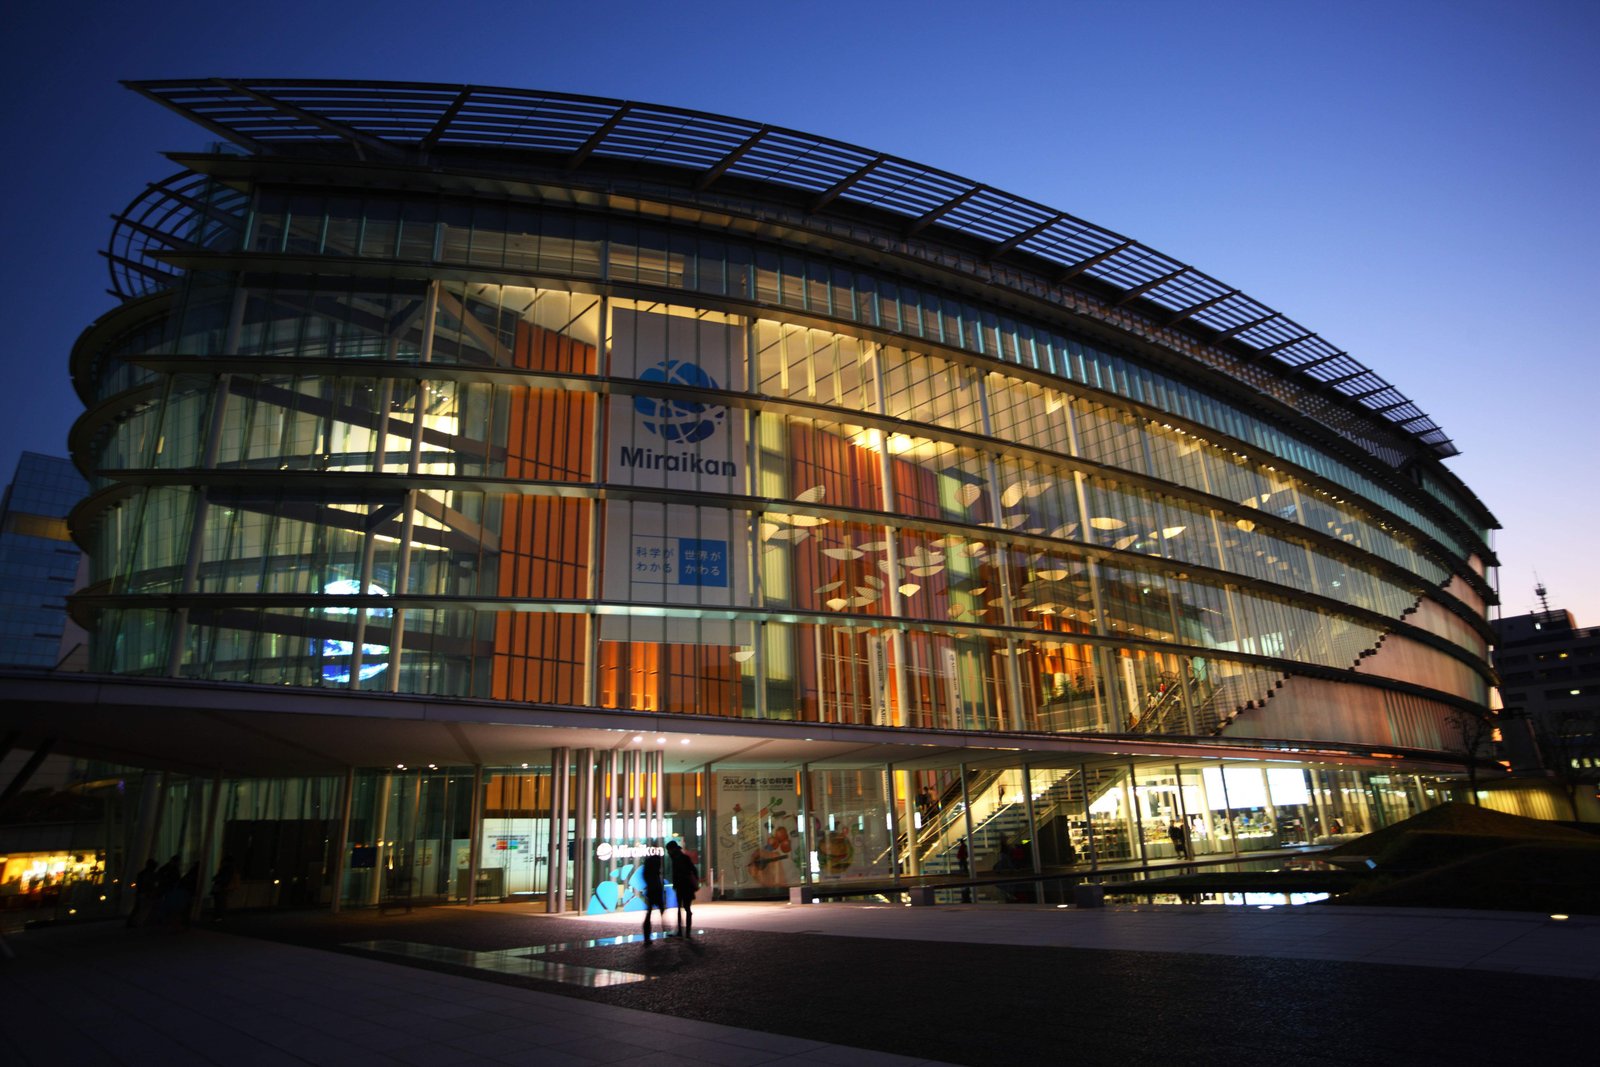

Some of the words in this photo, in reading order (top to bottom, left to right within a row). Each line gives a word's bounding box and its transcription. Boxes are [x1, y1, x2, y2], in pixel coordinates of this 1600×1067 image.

[620, 446, 737, 477] Miraikan
[636, 546, 674, 559] 科学が
[684, 549, 722, 562] 世界が
[636, 561, 673, 574] わかる
[685, 564, 721, 577] かわる
[612, 844, 665, 858] Miraikan
